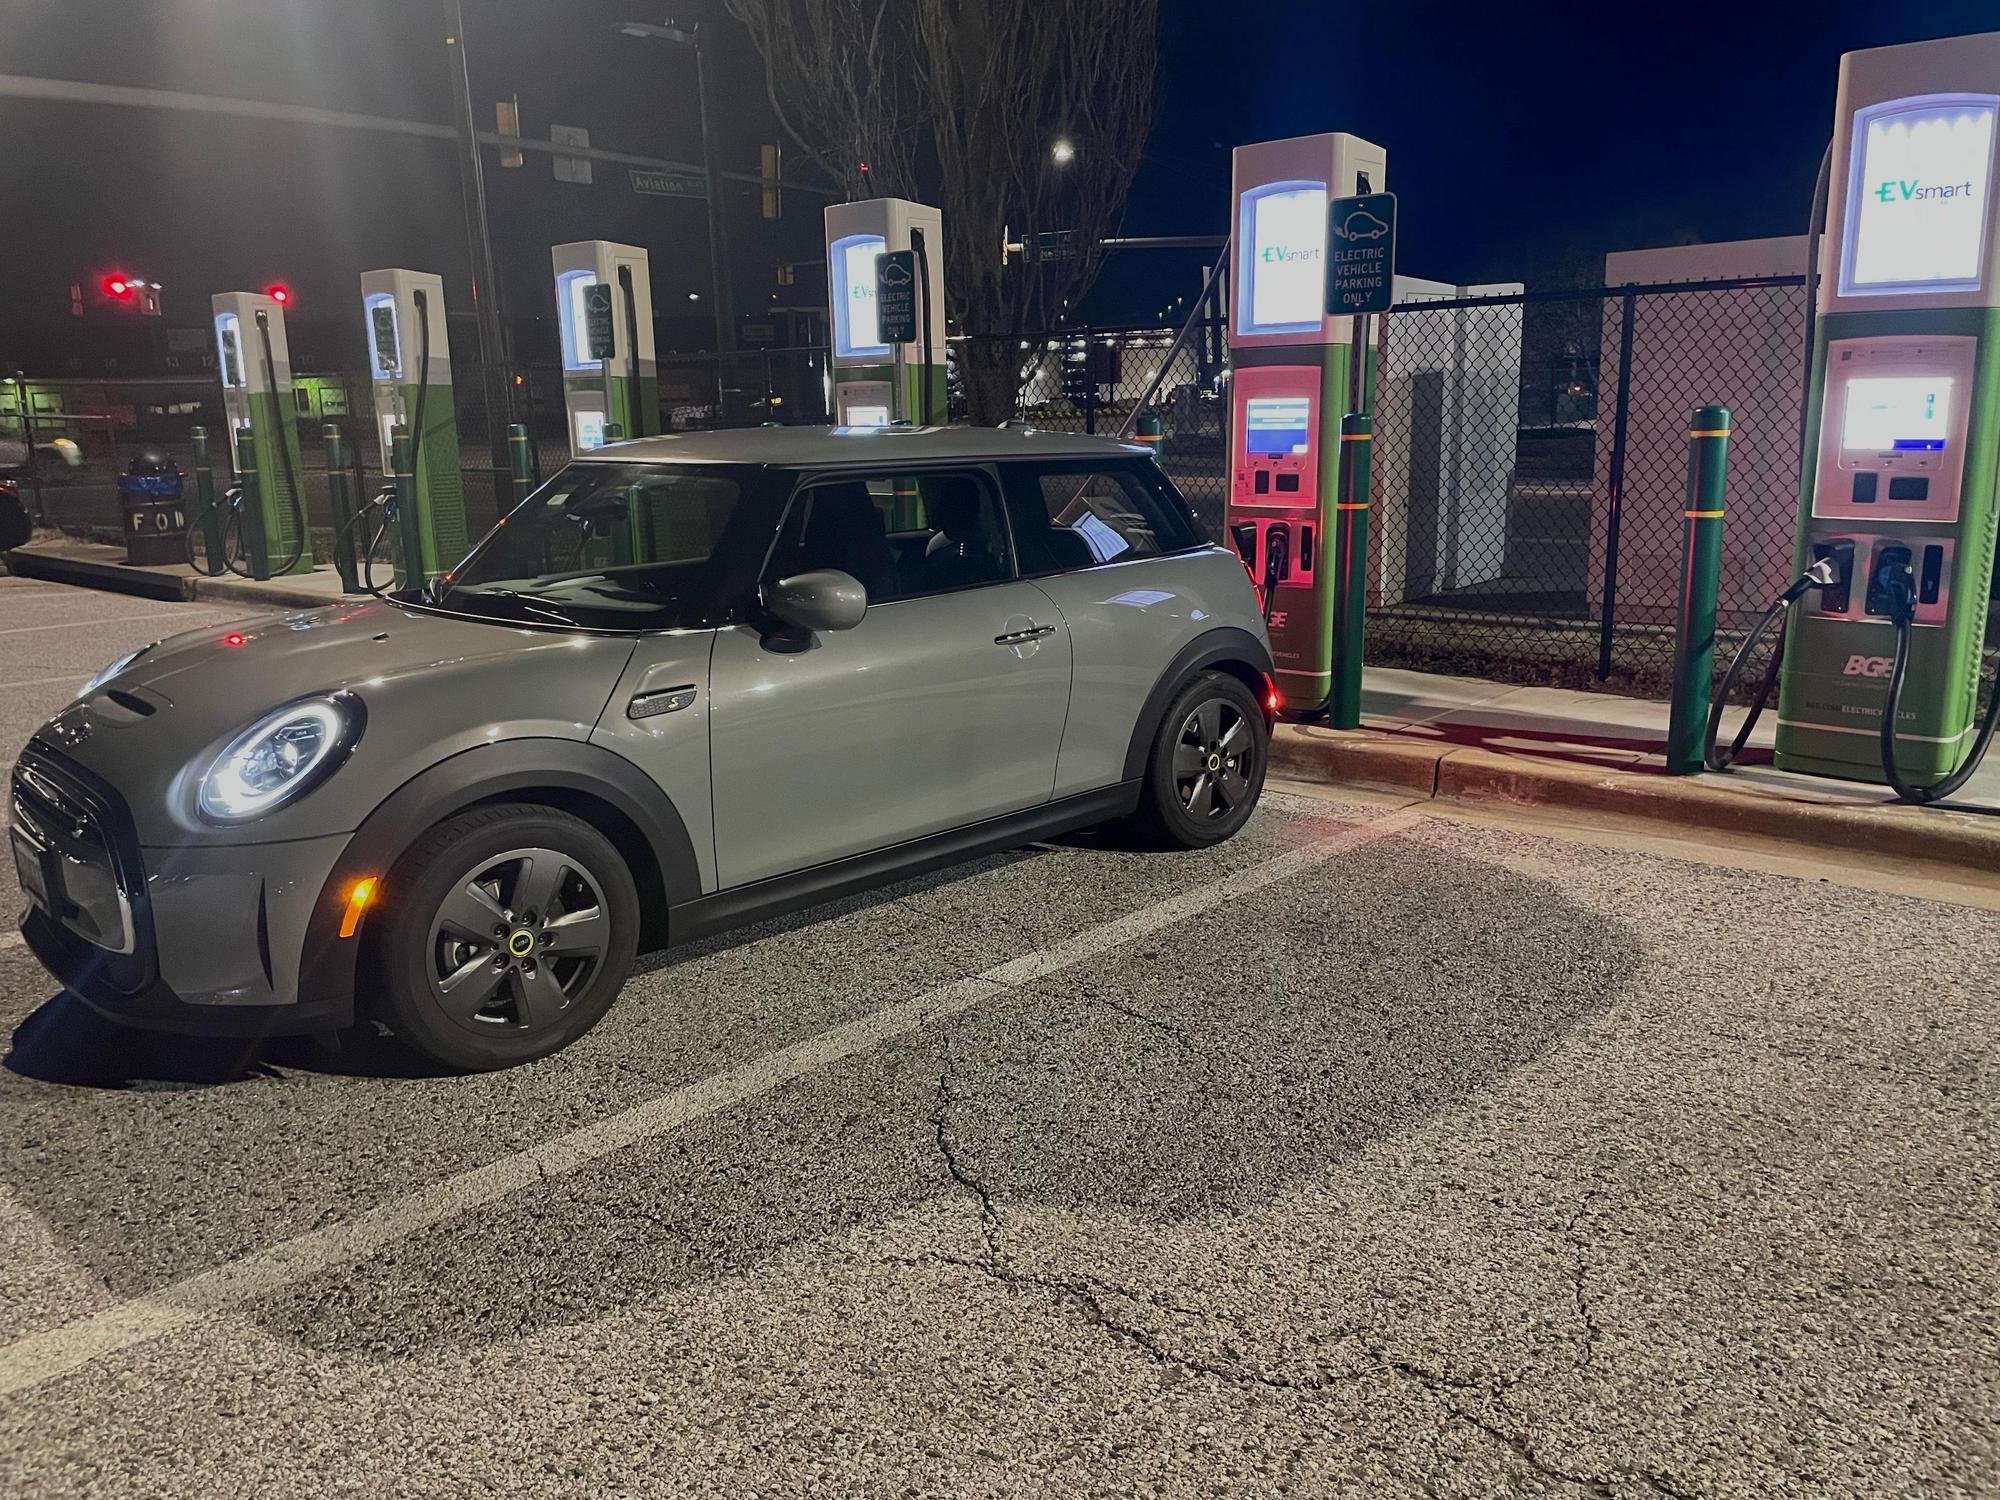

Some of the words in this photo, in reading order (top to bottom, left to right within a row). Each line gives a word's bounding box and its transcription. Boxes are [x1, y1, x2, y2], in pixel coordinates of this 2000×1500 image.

[635, 176, 684, 193] Aviation
[1875, 179, 1973, 203] EVsmart
[1262, 245, 1319, 262] EVsmart
[1334, 247, 1385, 262] ELECTRIC
[1336, 262, 1382, 276] VEHICLE
[1334, 277, 1383, 290] PARKING
[880, 291, 911, 302] ELECTRIC
[1343, 291, 1373, 304] ONLY
[881, 302, 910, 313] VEHICLE
[881, 313, 911, 325] PARKING
[887, 326, 905, 336] ONLY
[1842, 655, 1895, 678] BGE
[668, 696, 680, 709] S
